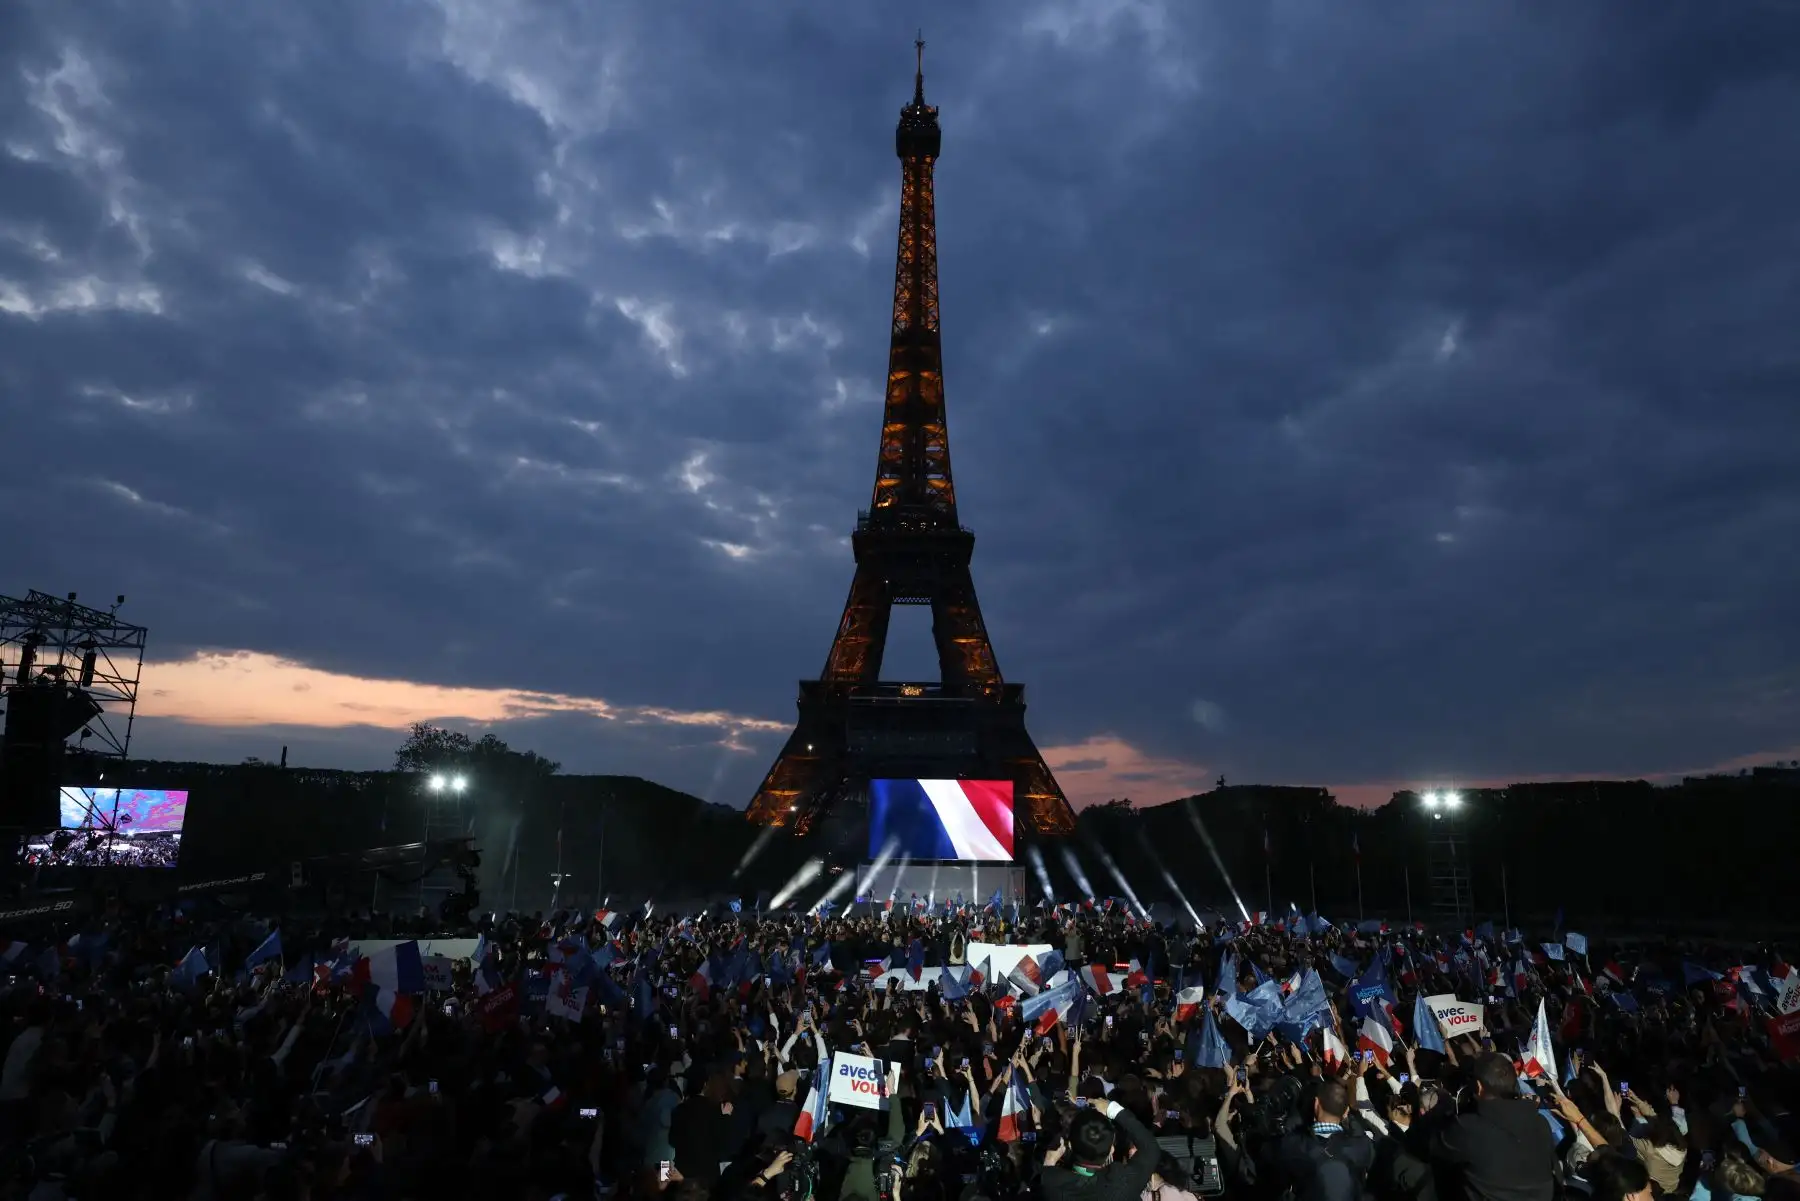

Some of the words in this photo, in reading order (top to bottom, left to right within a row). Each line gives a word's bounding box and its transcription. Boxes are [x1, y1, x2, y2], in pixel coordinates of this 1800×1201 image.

[1437, 1007, 1465, 1019] avec
[1447, 1015, 1477, 1026] vous
[839, 1064, 878, 1081] avec
